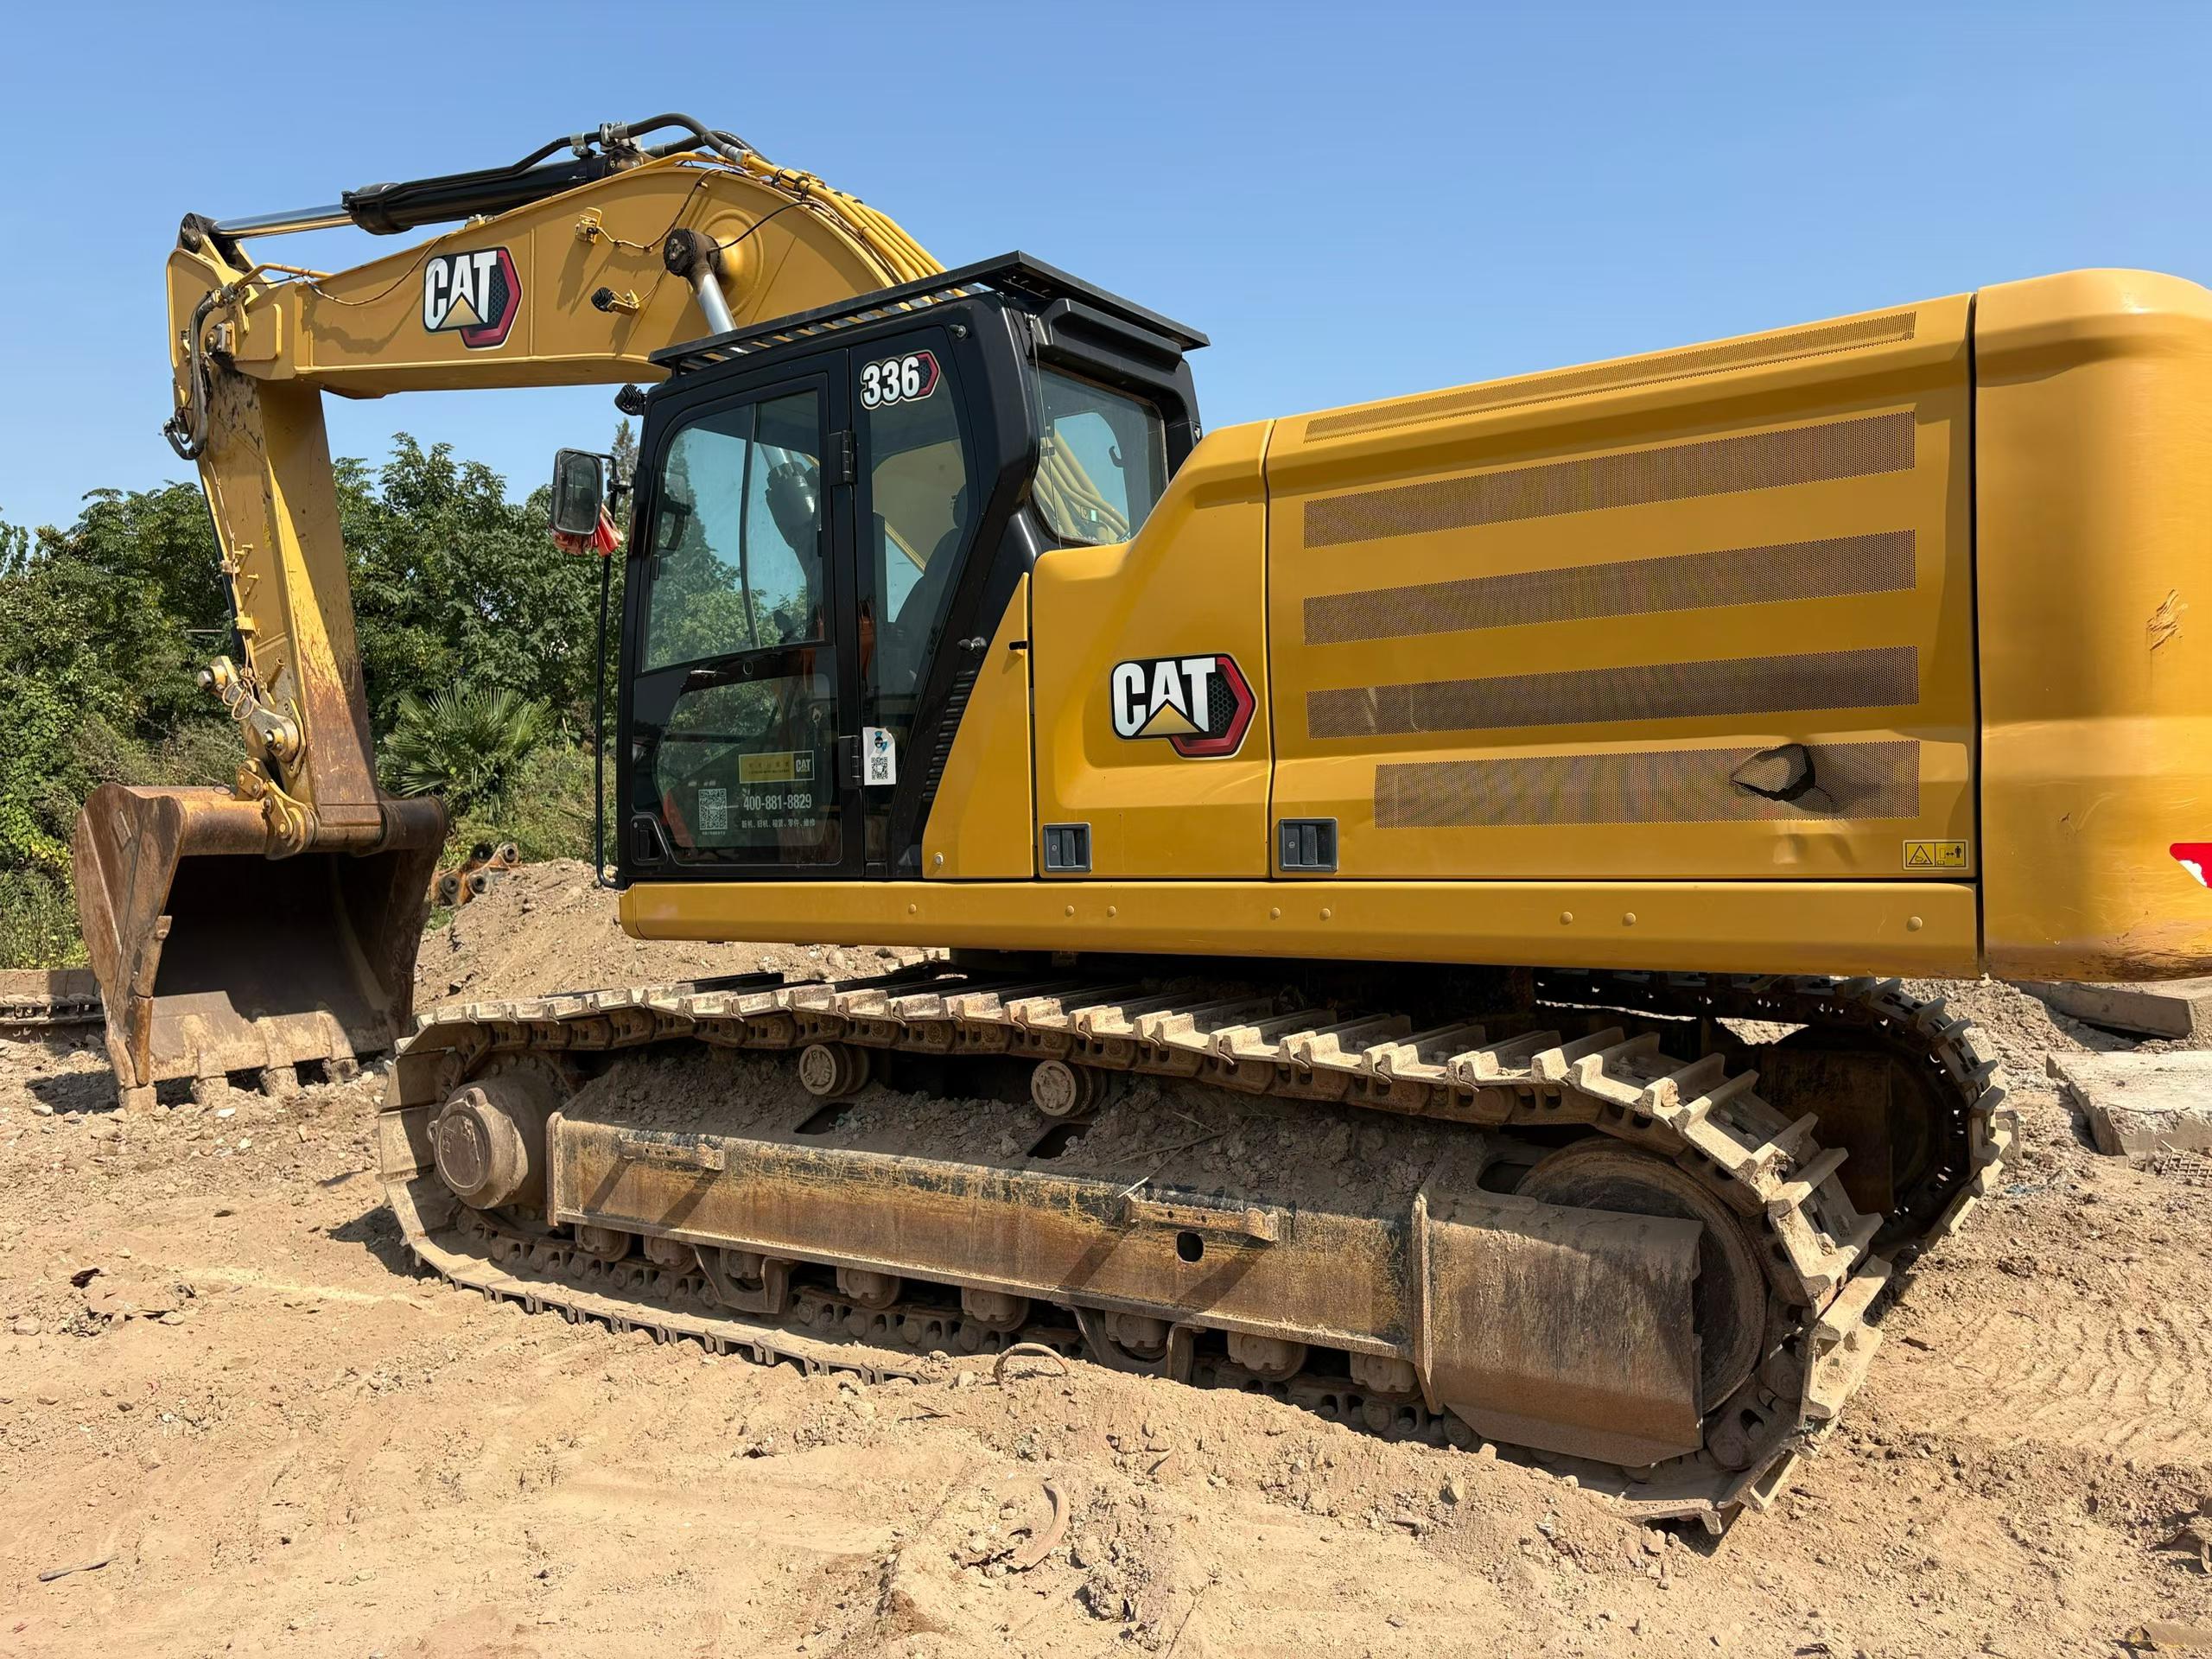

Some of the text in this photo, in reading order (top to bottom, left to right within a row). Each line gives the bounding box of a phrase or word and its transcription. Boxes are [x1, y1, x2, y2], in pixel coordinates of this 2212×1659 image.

[424, 250, 498, 330] CAT
[863, 356, 920, 405] 336
[1112, 657, 1216, 736] CAT
[795, 759, 811, 772] CAT
[743, 793, 812, 810] 400-881-8829
